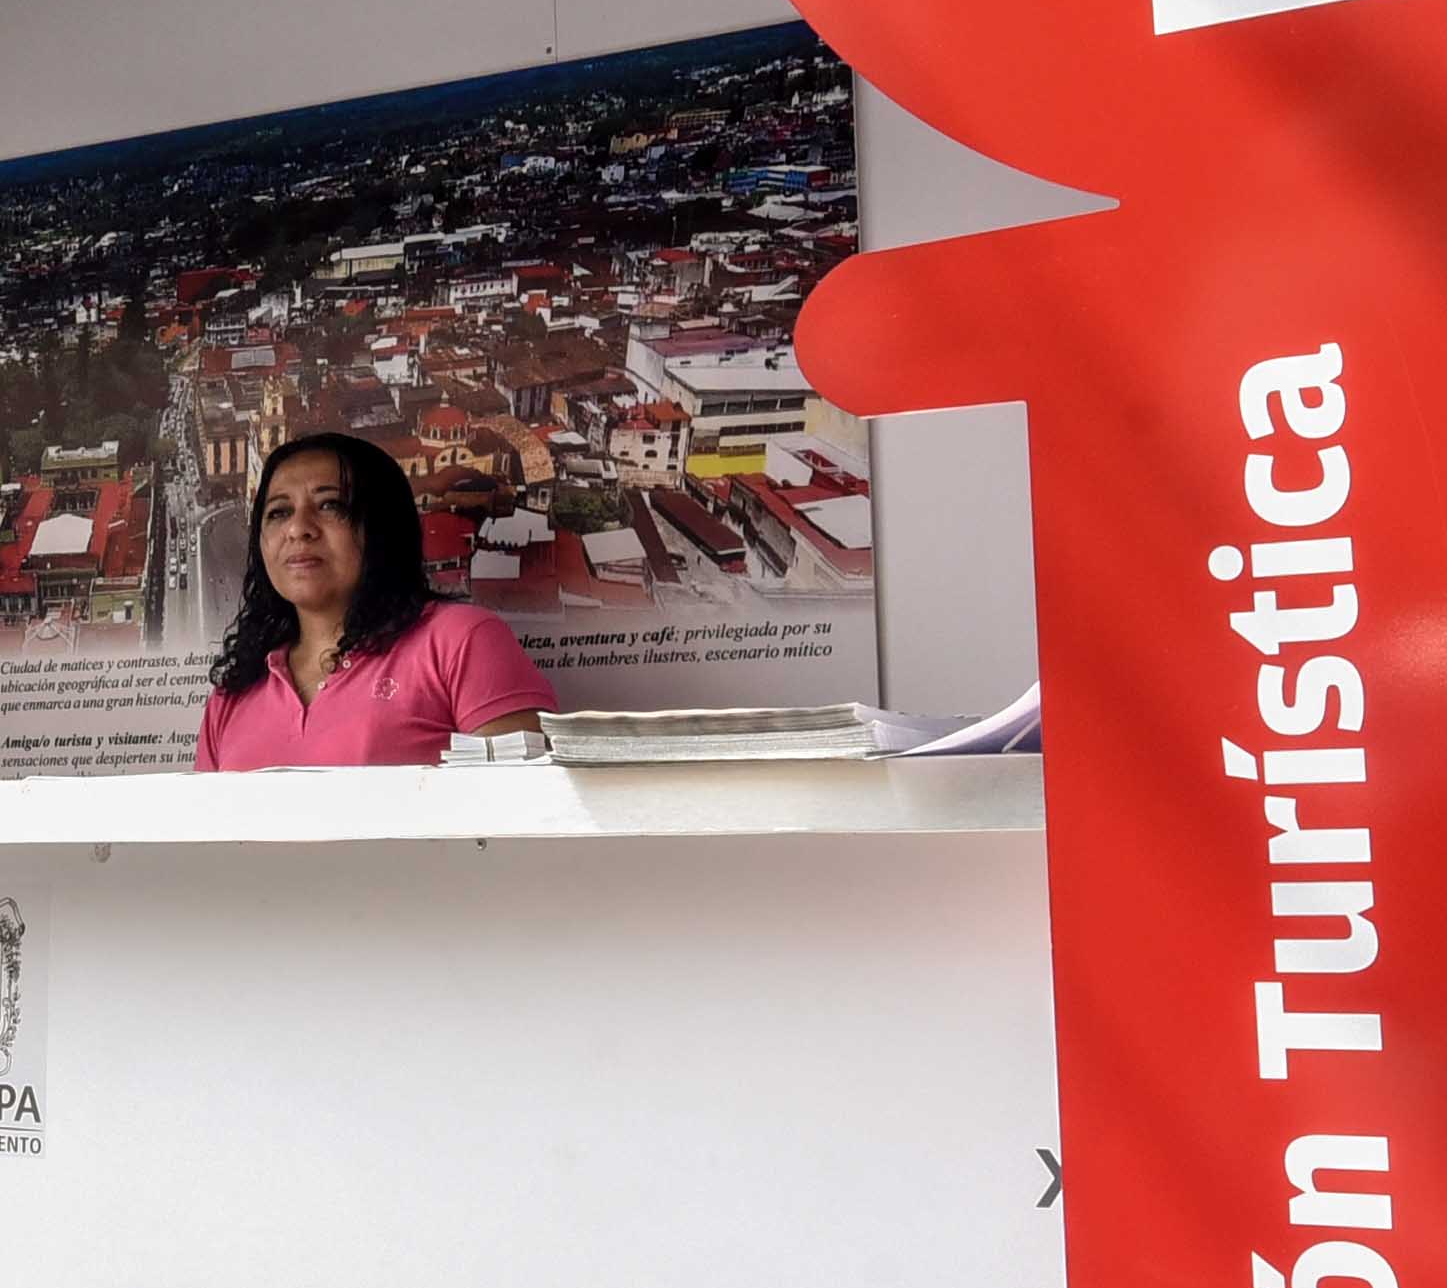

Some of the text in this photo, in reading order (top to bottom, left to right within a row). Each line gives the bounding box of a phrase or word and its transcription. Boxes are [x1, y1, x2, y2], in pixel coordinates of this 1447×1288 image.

[560, 619, 832, 648] aventura y café; privilegiada por su
[0, 655, 180, 675] Ciudad de matices y contrastes,
[557, 640, 833, 668] de hombres ilustres, escenario mítico
[0, 672, 208, 694] ubicación geográfica al ser el centro
[1, 700, 21, 715] que
[23, 699, 72, 712] enmarca
[73, 699, 82, 710] a
[82, 698, 104, 709] una
[106, 697, 134, 712] gran
[136, 693, 185, 710] historia,
[1208, 343, 1382, 1079] Turística
[1, 731, 163, 751] Amiga/o turista y visitante:
[1, 751, 174, 770] sensaciones que despierten su
